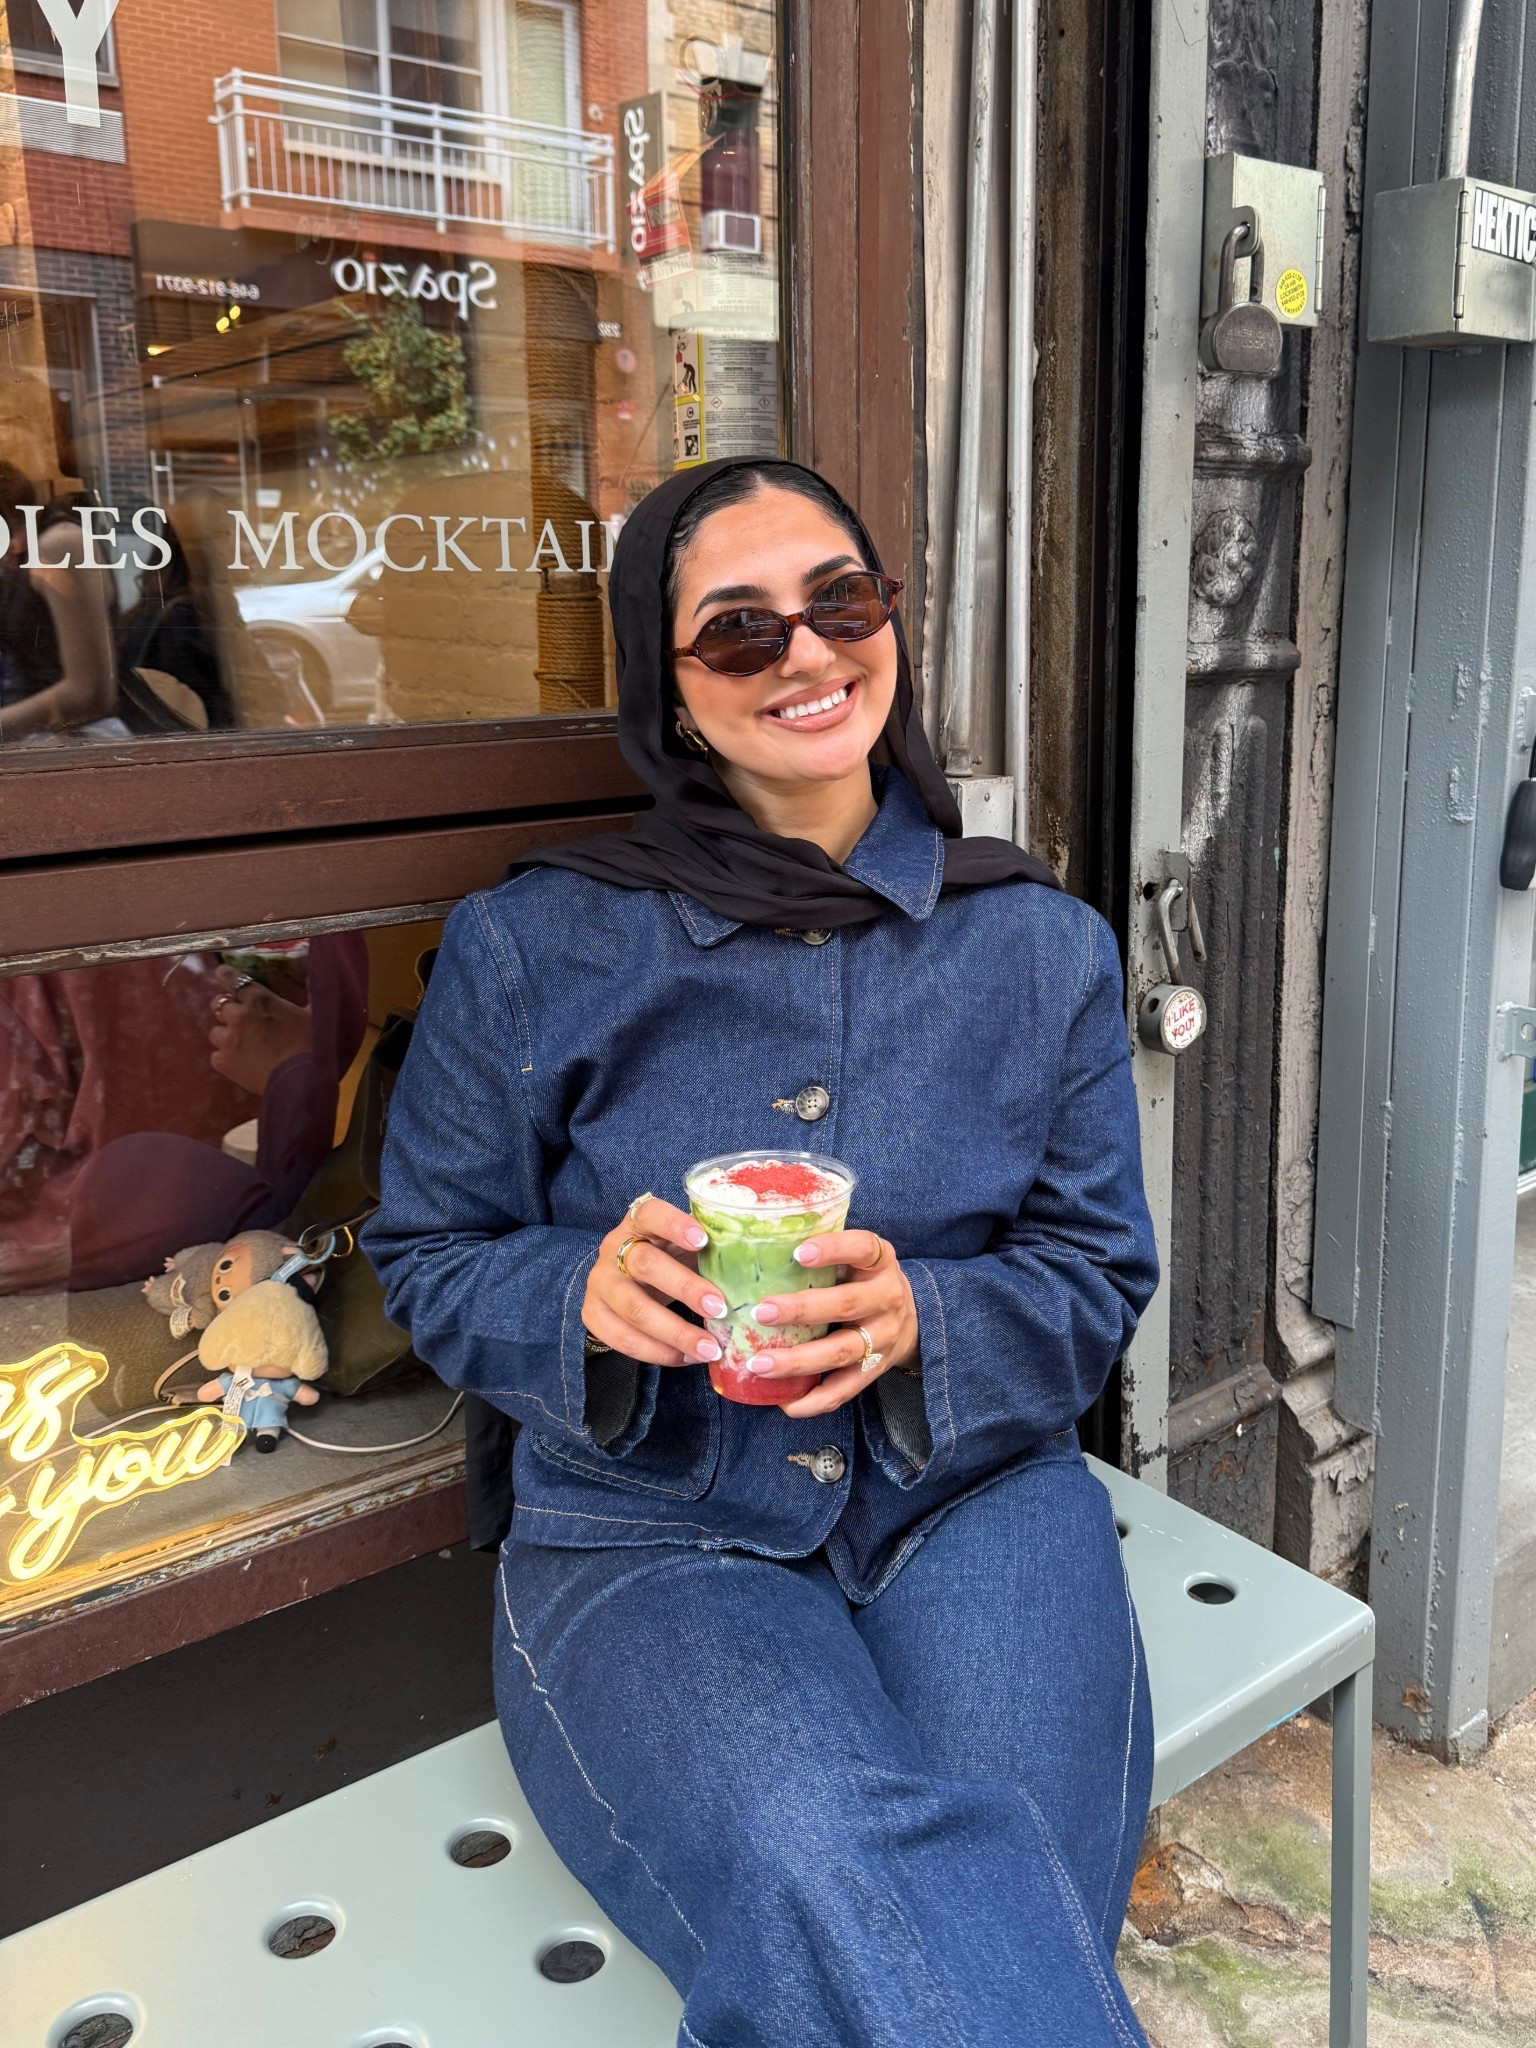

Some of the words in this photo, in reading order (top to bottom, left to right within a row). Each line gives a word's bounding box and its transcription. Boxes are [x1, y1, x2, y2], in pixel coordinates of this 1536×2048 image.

[1280, 284, 1304, 300] LOCKSMITH
[1227, 328, 1274, 340] AMERICAN
[1242, 338, 1267, 350] LOCK
[0, 505, 172, 571] LES
[1174, 998, 1195, 1023] LIKE
[8, 1418, 237, 1580] you
